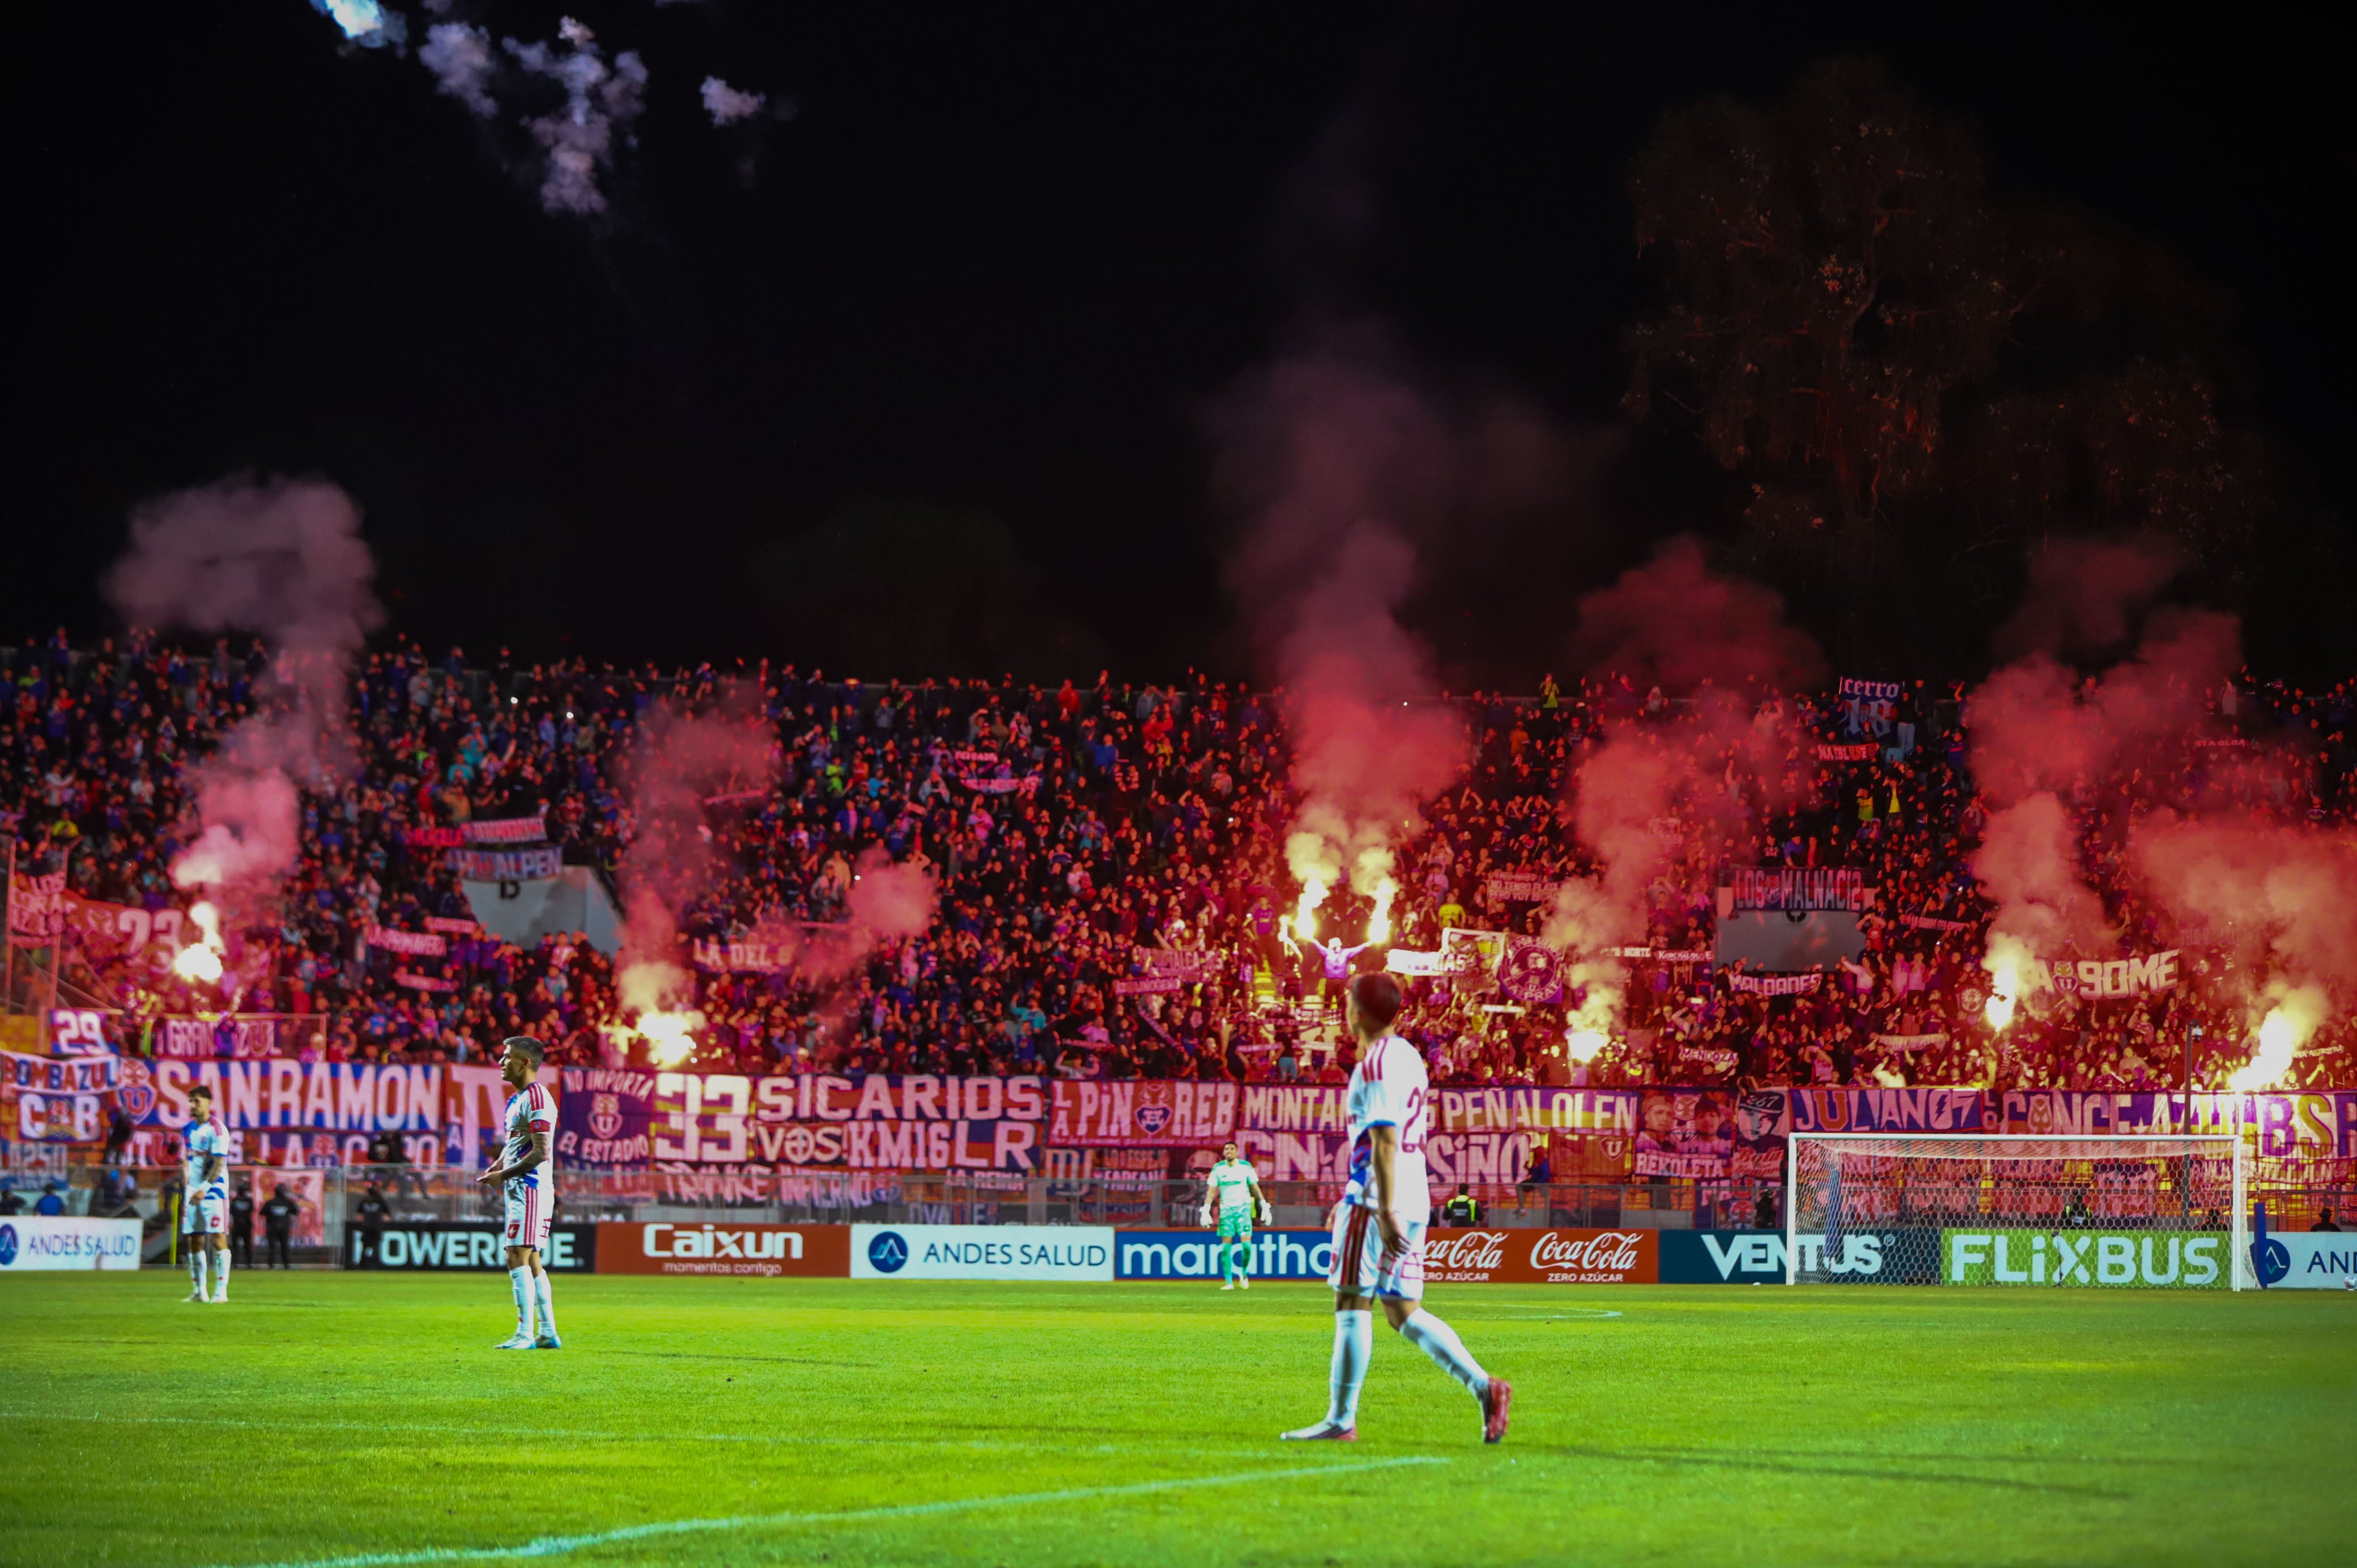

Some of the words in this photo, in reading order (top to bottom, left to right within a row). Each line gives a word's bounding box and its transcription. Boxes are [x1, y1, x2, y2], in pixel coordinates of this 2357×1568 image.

[1844, 678, 1899, 698] cerro
[1735, 870, 1765, 909] LOS
[1523, 980, 1559, 1002] PRAT
[56, 1011, 111, 1055] 29
[231, 1020, 282, 1057] ZUL
[1681, 1047, 1737, 1063] MENDOZA
[586, 1070, 654, 1102] IMPORTA
[757, 1074, 1044, 1122] SICARIOS
[655, 1072, 751, 1161] 33
[1401, 1085, 1427, 1153] 2
[581, 1133, 650, 1162] ESTADIO
[1635, 1152, 1725, 1178] REKOLETA
[28, 1234, 80, 1256] ANDES
[84, 1235, 136, 1256] SALUD
[924, 1243, 1012, 1265] ANDES
[1019, 1243, 1106, 1267] SALUD
[1122, 1233, 1333, 1276] maratho
[1423, 1231, 1510, 1269] ca-Cola
[1530, 1232, 1644, 1270] Coca-Cola
[1700, 1234, 1883, 1281] VENTUS
[663, 1262, 731, 1273] momentos
[735, 1262, 782, 1277] contigo
[1423, 1273, 1444, 1281] ERO
[1445, 1270, 1489, 1281] AZÚCAR
[1547, 1273, 1578, 1282] ZERO
[1579, 1270, 1624, 1282] AZÚCAR
